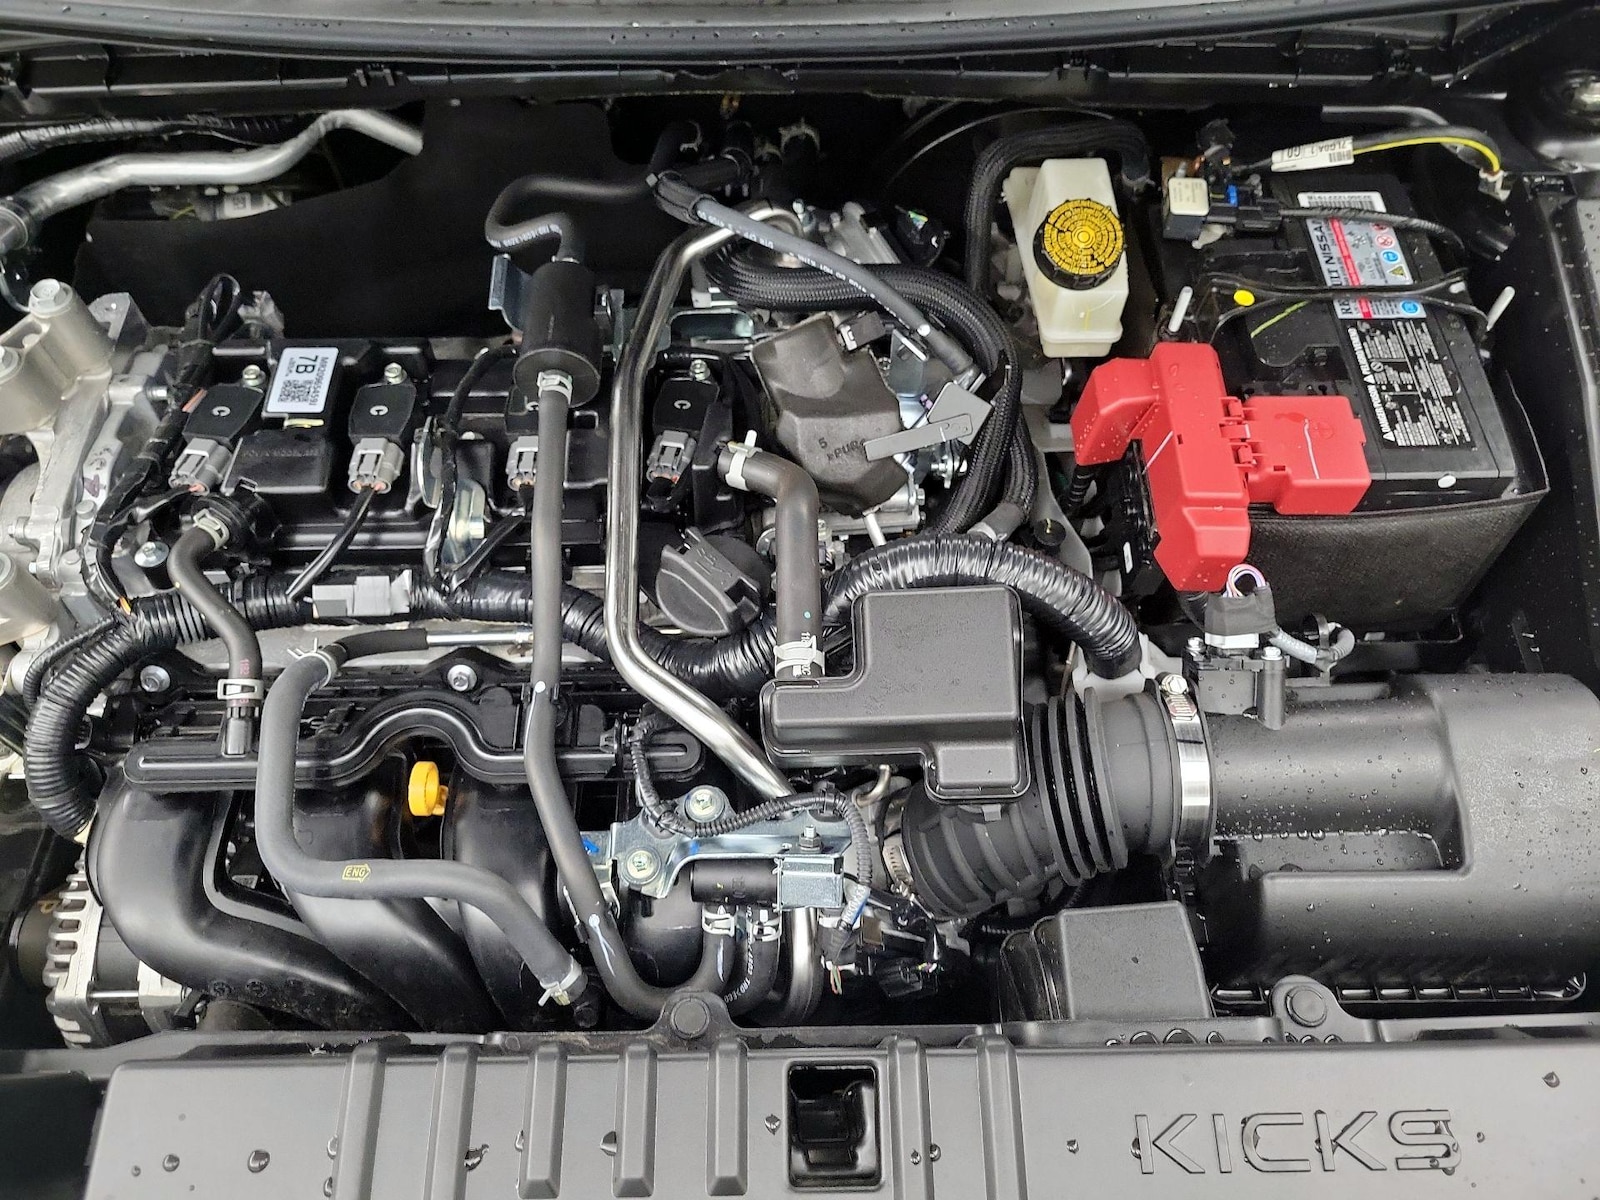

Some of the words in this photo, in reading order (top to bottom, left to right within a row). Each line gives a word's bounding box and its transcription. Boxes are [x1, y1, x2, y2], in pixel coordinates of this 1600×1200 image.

[1327, 268, 1354, 316] REULT
[295, 354, 318, 374] 7B
[345, 866, 366, 877] ENG
[1134, 1109, 1462, 1175] KICKS
